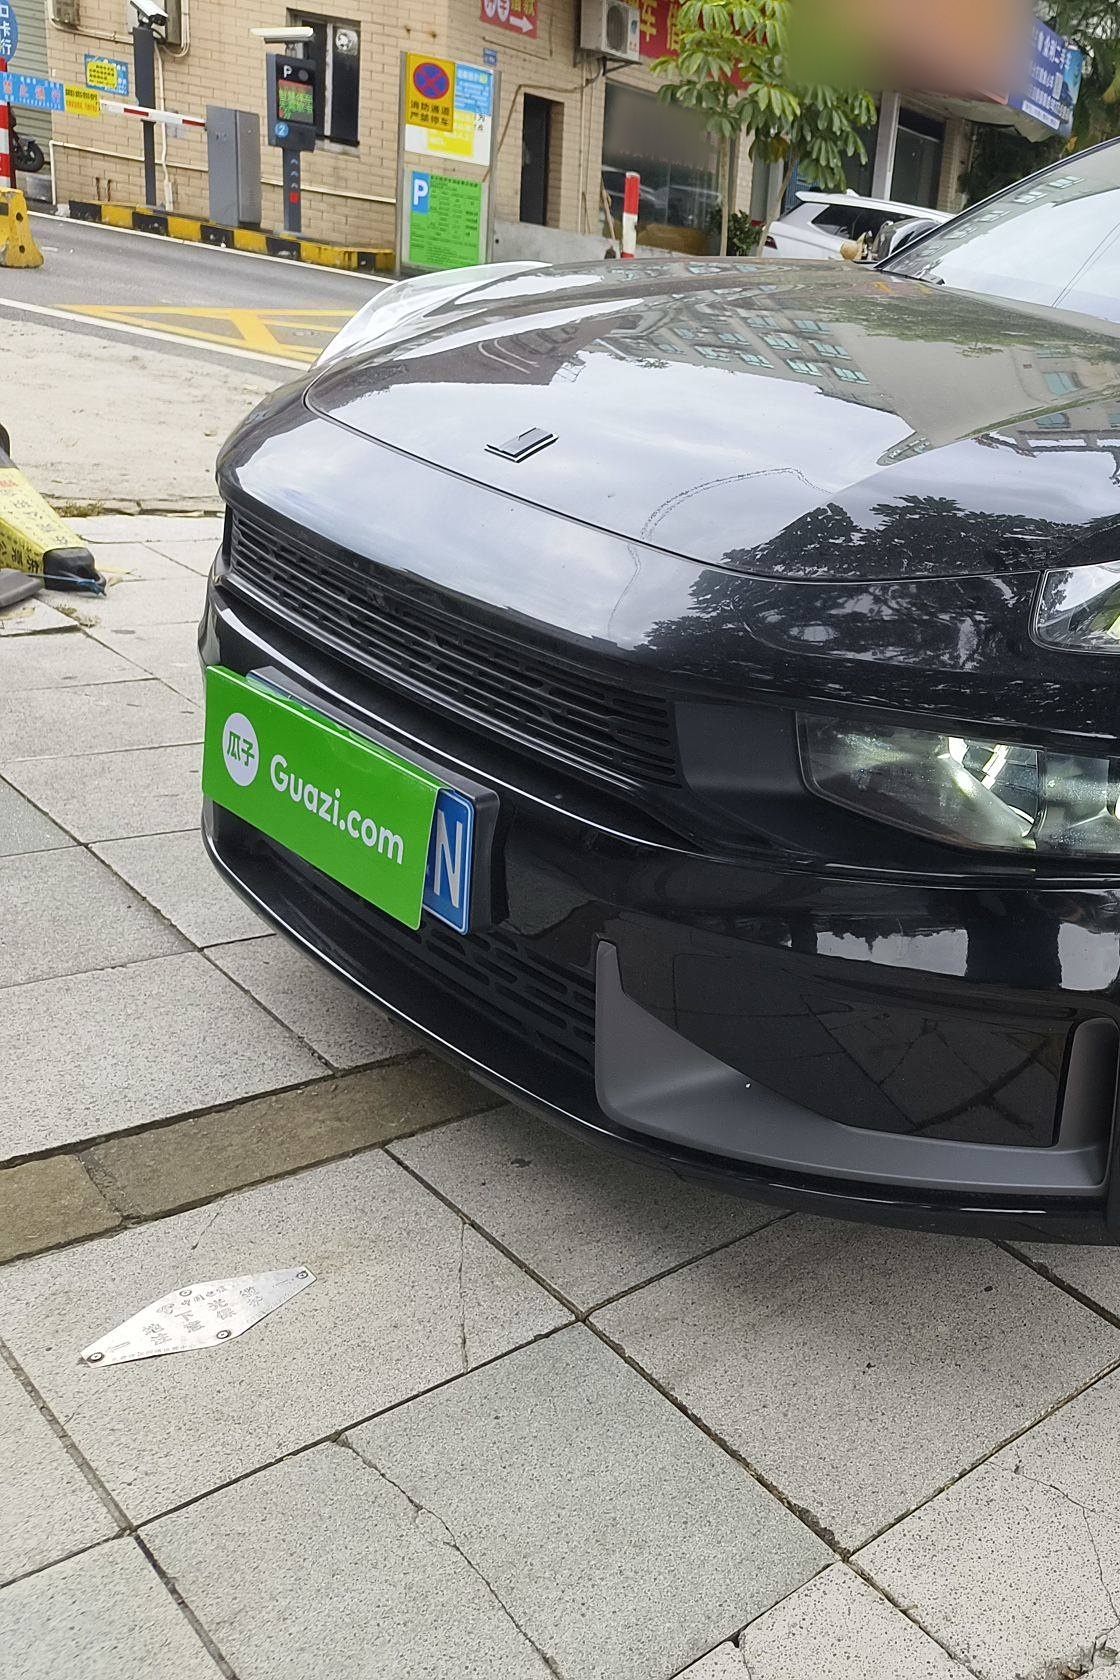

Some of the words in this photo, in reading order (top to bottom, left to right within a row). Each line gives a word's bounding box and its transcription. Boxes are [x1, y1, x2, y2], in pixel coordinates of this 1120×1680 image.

[283, 65, 293, 78] P
[413, 179, 429, 206] P
[227, 731, 256, 767] 瓜子
[270, 754, 404, 865] Guazi.com
[433, 809, 463, 909] N
